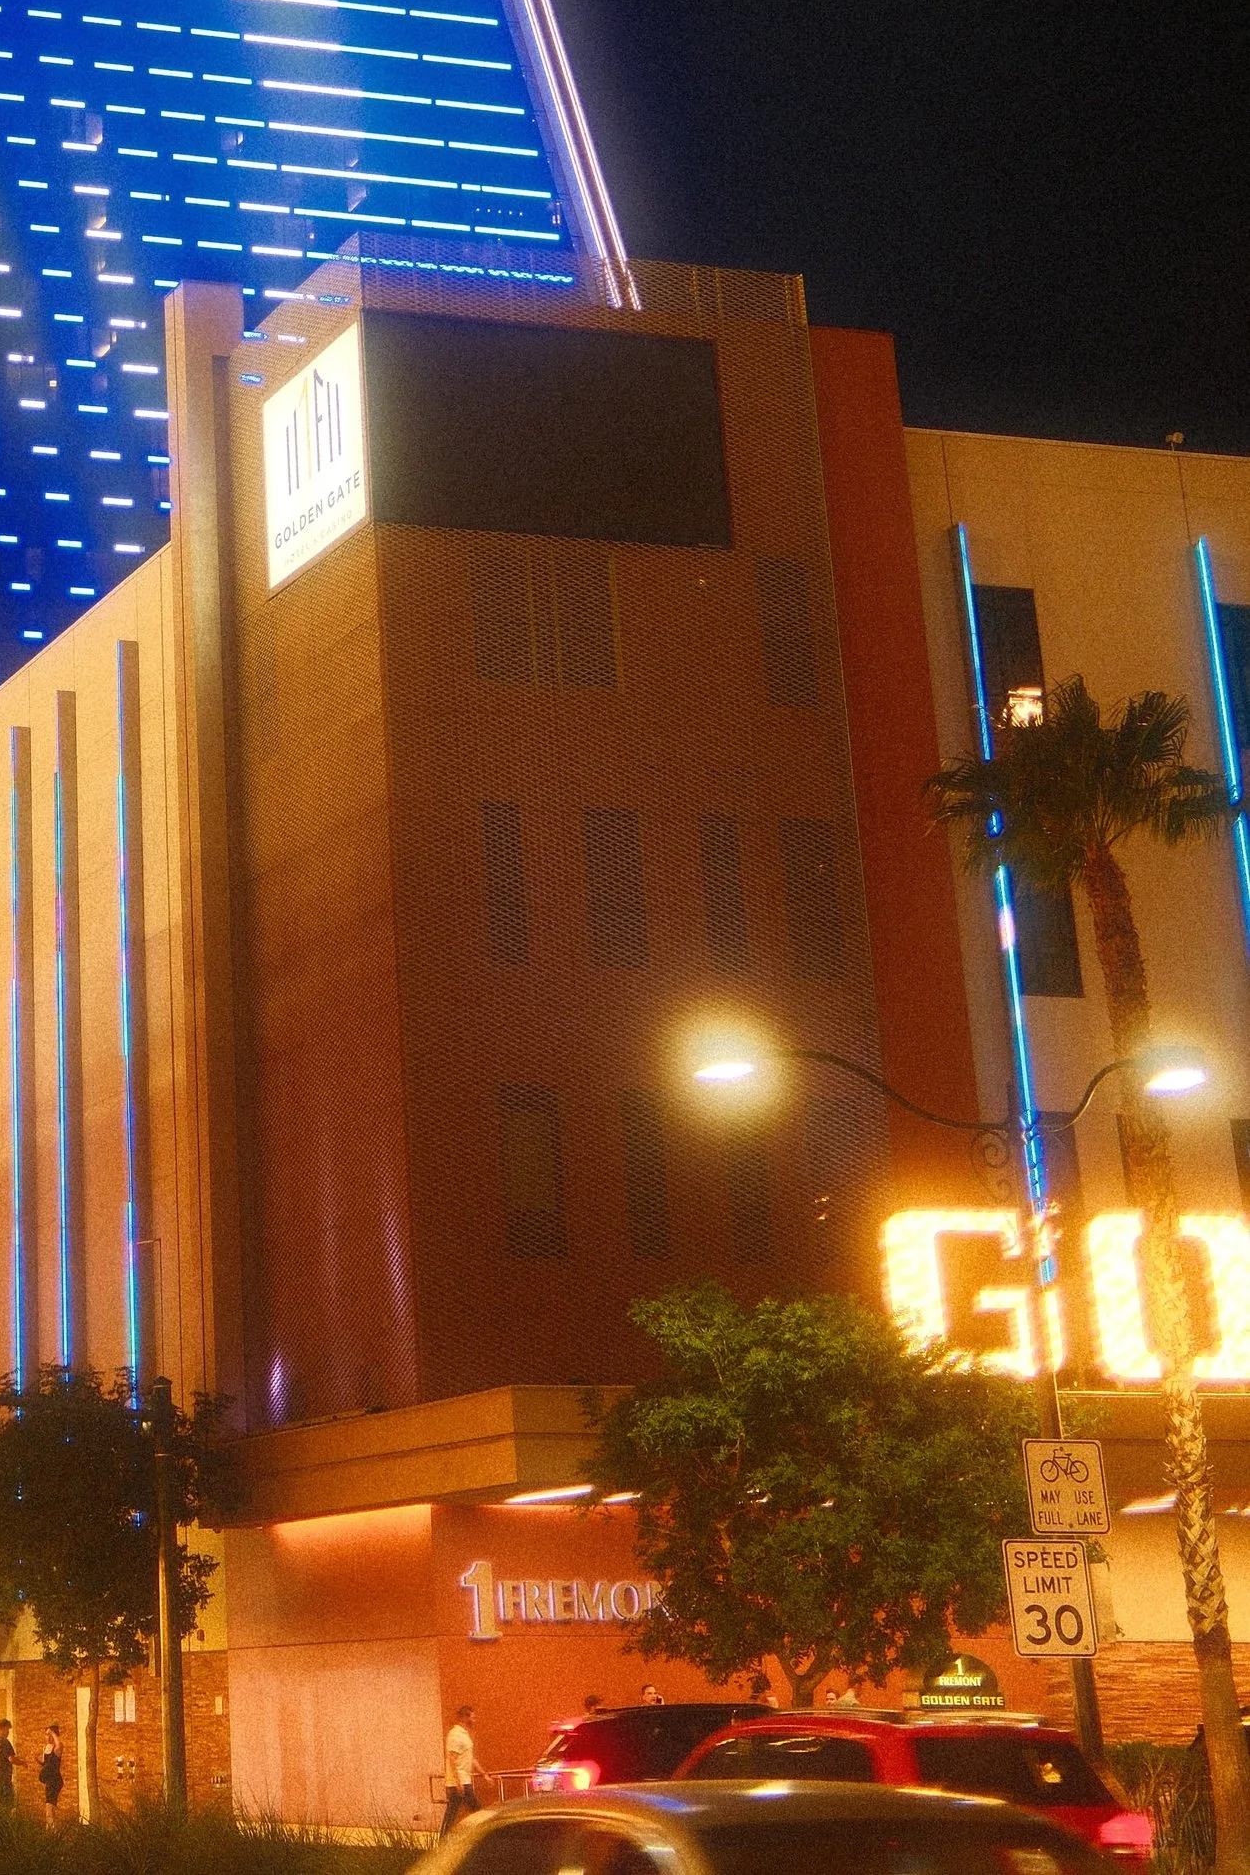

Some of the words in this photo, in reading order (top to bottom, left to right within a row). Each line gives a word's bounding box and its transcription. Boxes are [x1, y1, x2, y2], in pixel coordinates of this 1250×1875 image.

[275, 499, 323, 549] GOLDEN
[327, 469, 361, 508] GATE
[1040, 1490, 1061, 1504] MAY
[1074, 1490, 1096, 1505] USE
[1038, 1511, 1064, 1526] FULL
[1076, 1511, 1104, 1526] LANE
[1014, 1550, 1078, 1569] SPEED
[1023, 1576, 1073, 1595] LIMIT
[461, 1560, 503, 1642] 1
[1024, 1604, 1084, 1646] 30
[954, 1658, 965, 1676] 1
[938, 1676, 982, 1687] FREMONT
[921, 1695, 970, 1706] GOLDEN
[972, 1696, 1005, 1706] GATE
